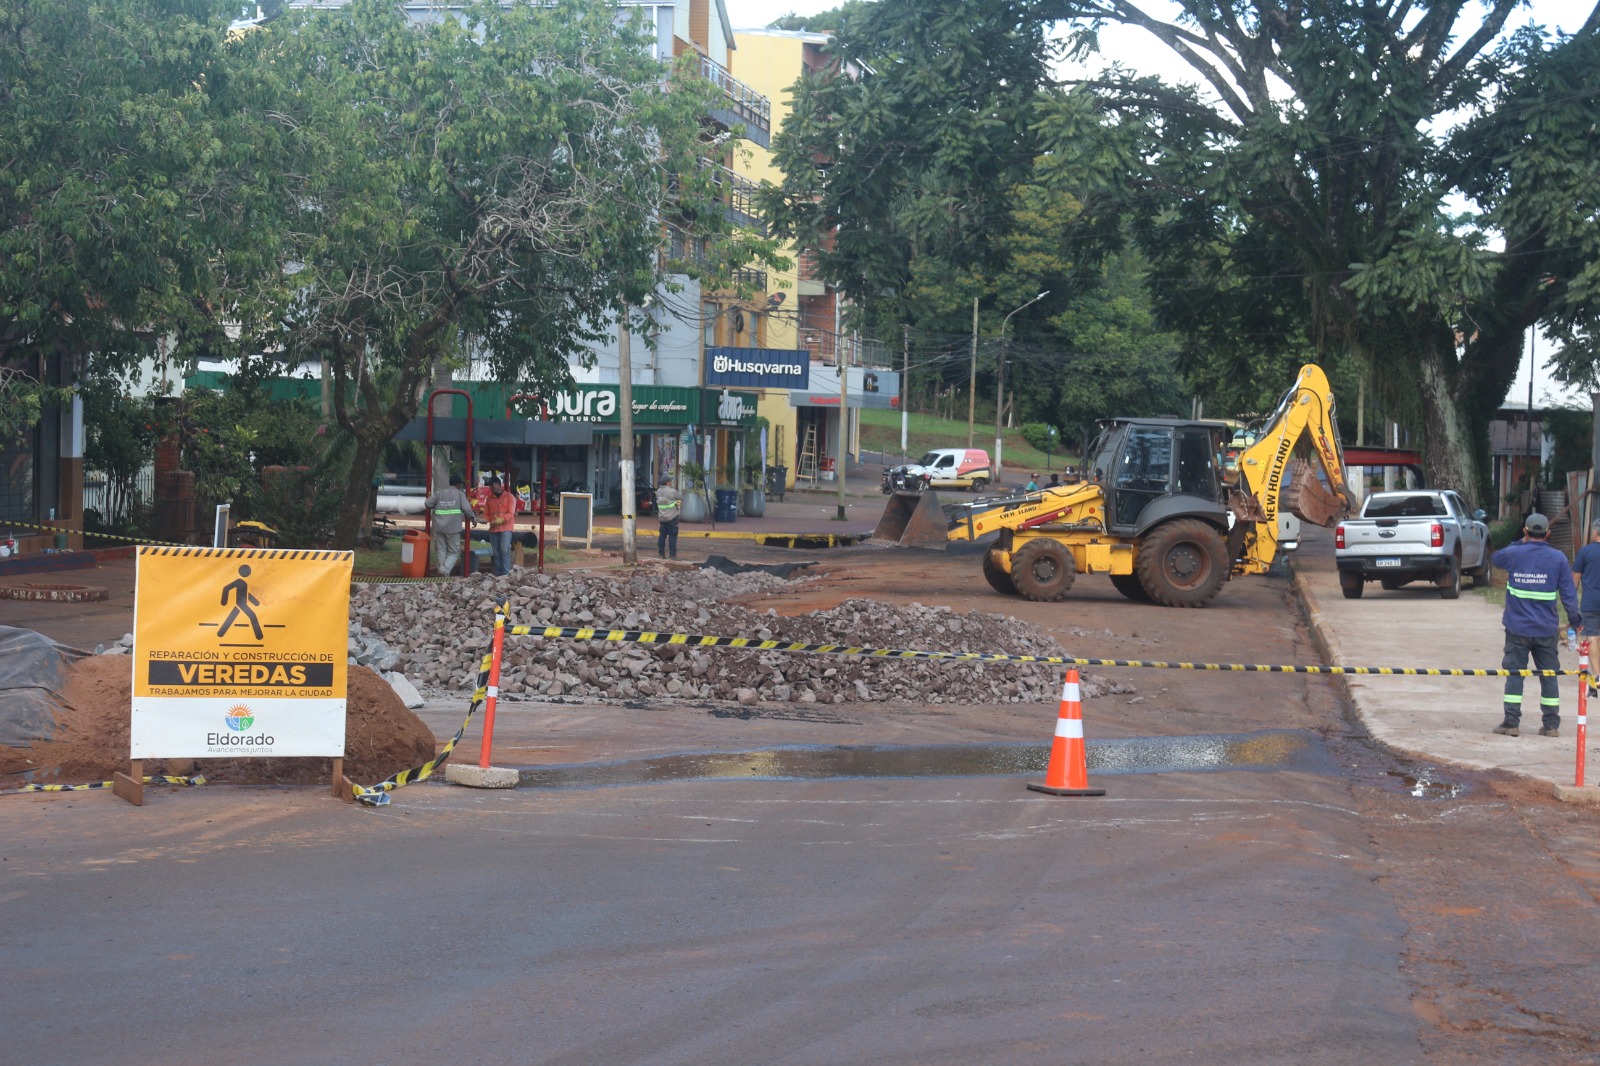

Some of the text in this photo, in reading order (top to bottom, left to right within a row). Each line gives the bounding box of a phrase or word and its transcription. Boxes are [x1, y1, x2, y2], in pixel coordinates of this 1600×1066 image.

[728, 359, 802, 375] Husqvarna
[1266, 438, 1291, 522] NEW HOLLAND
[150, 650, 219, 660] REPARACIÓN
[233, 651, 317, 661] CONSTRUCCIÓN
[178, 664, 306, 684] VEREDAS
[150, 688, 210, 696] TRABAJAMOS
[207, 733, 275, 745] Eldorado
